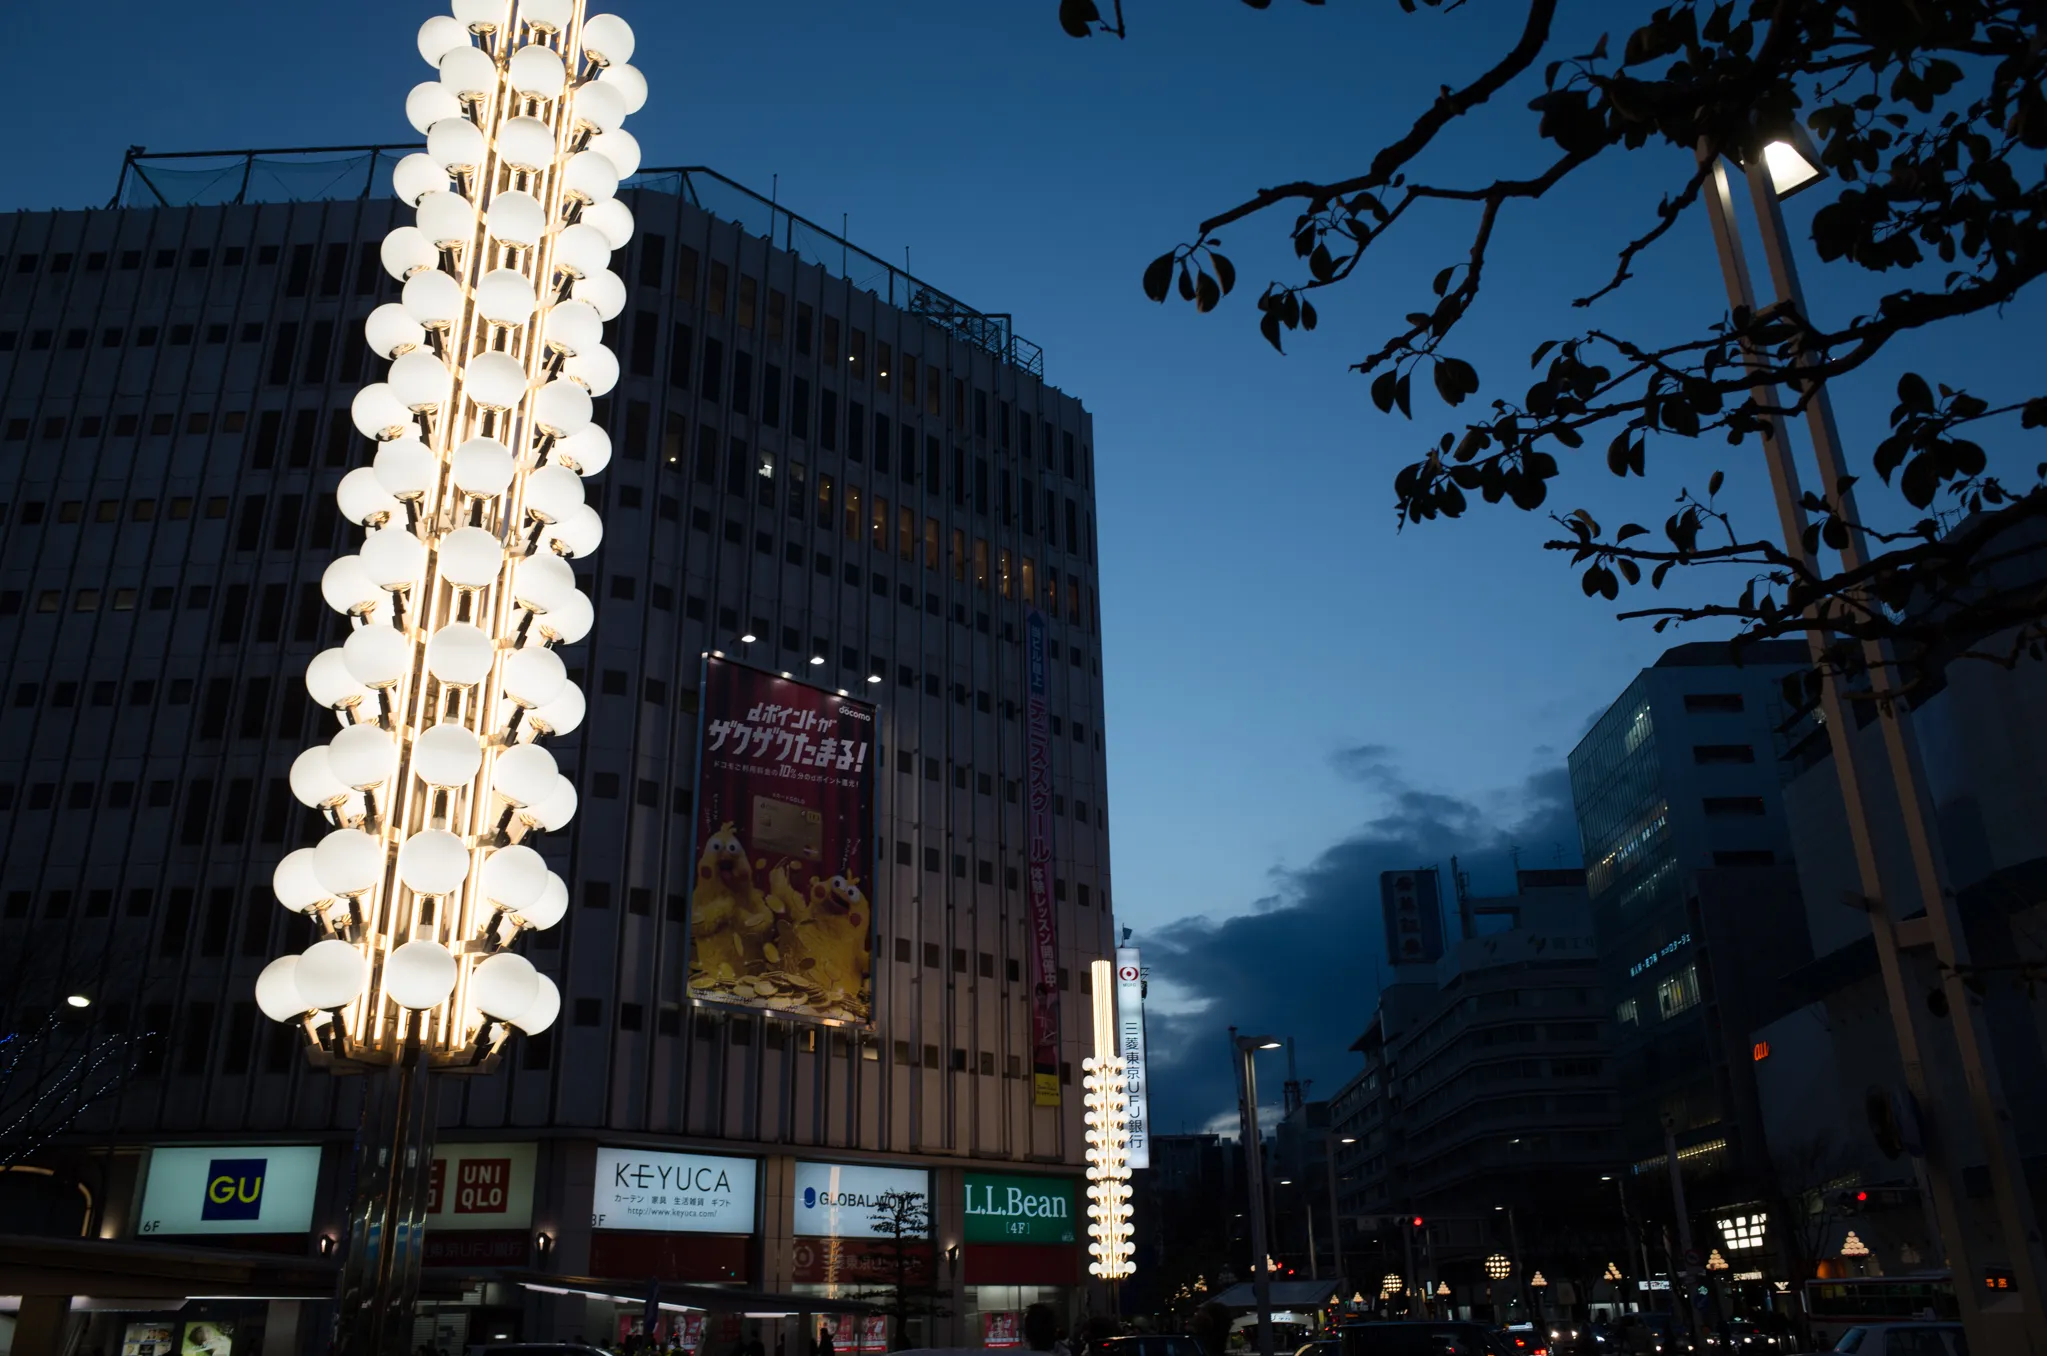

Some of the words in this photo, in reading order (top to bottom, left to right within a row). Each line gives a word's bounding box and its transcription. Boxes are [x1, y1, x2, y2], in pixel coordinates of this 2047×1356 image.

[746, 702, 838, 734] dポイントが
[838, 705, 872, 722] docomo
[1030, 698, 1050, 861] テニススクール
[1753, 1040, 1770, 1061] au
[1125, 1022, 1143, 1149] 三菱東京UFJ銀行
[463, 1165, 501, 1185] UNI
[615, 1162, 731, 1193] KEYUCA
[208, 1175, 262, 1204] GU
[461, 1188, 502, 1211] QLO
[819, 1191, 874, 1208] GLOBAL
[964, 1184, 1068, 1218] L.L.Bean
[614, 1195, 645, 1203] カーテン
[651, 1196, 667, 1205] 家具
[711, 1199, 732, 1208] ギフト
[143, 1221, 160, 1232] 6F
